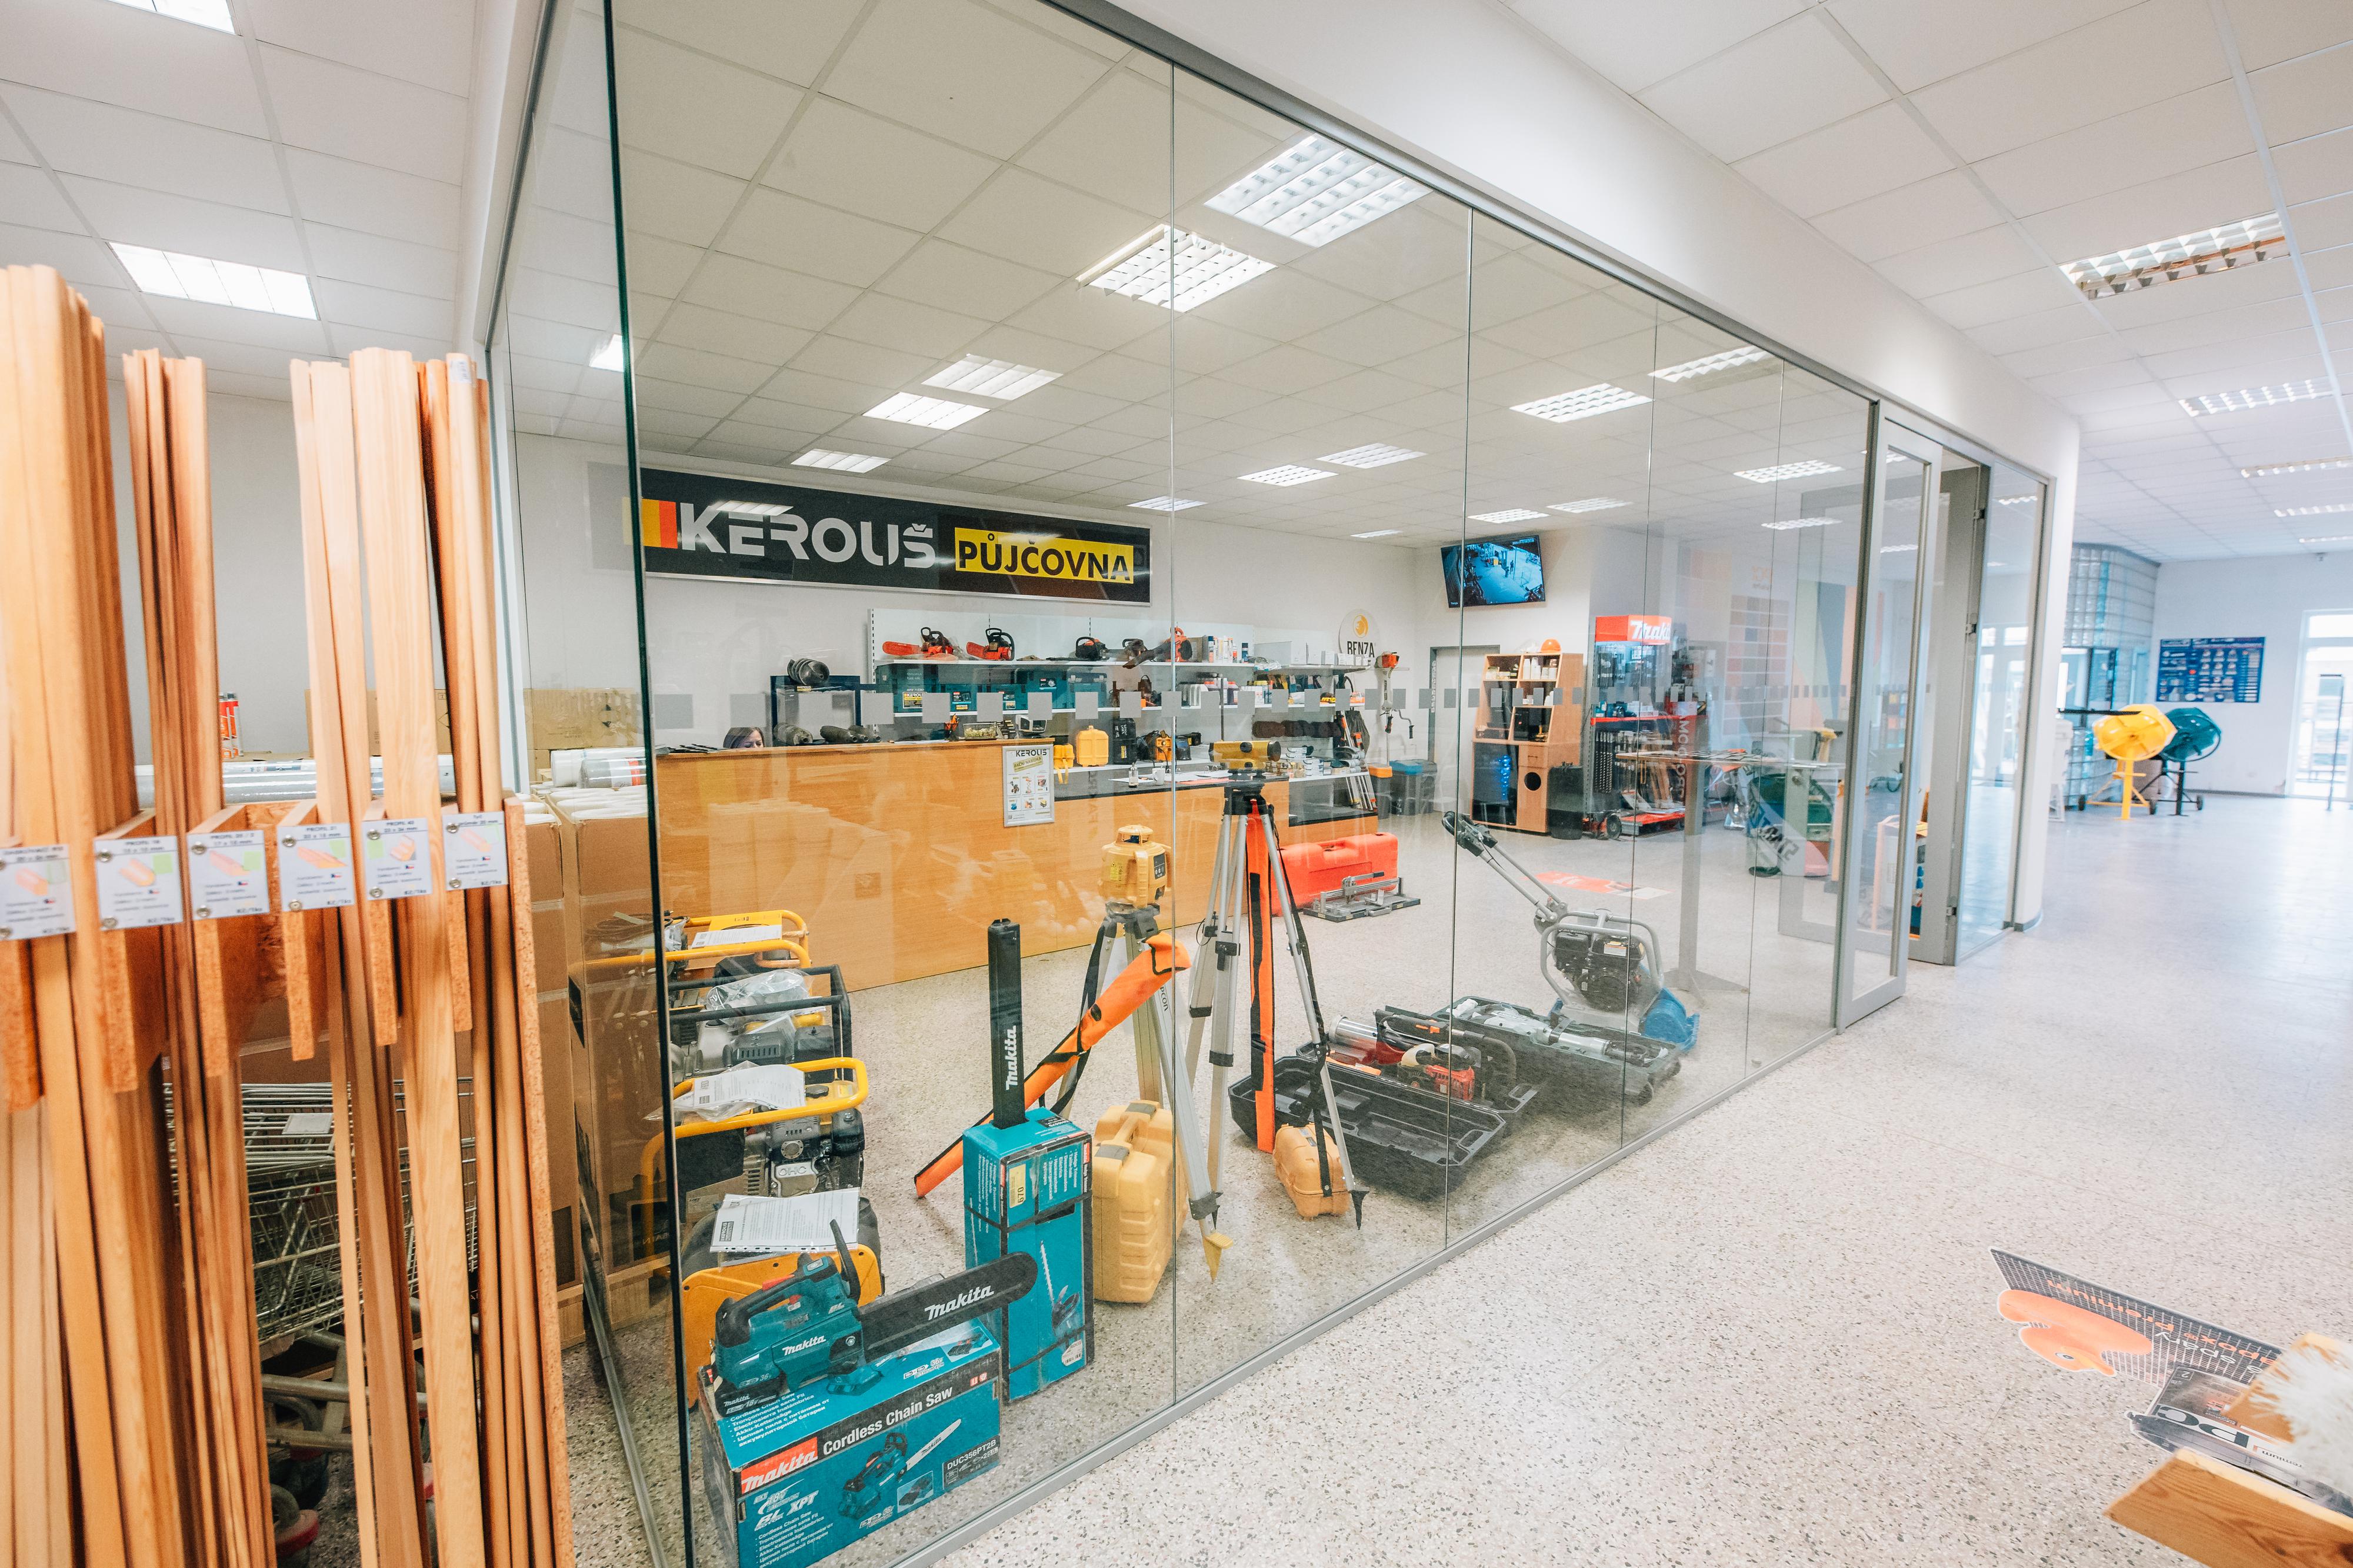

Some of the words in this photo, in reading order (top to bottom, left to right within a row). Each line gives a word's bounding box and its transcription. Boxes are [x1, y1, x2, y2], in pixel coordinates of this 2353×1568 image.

[679, 503, 936, 568] KEROUŠ
[958, 533, 1130, 582] PŮJČOVNA
[1347, 641, 1375, 658] BENZA
[1025, 756, 1042, 765] NABÍDKA
[2047, 1279, 2175, 1331] Premium
[2155, 1330, 2237, 1365] spáry
[730, 1408, 760, 1422] Cordless
[781, 1392, 795, 1400] Saw
[732, 1406, 779, 1426] Tronçonneuse
[780, 1397, 795, 1406] sans
[734, 1412, 776, 1431] Electrosierra
[777, 1394, 815, 1413] Inalámbrica
[823, 1420, 883, 1456] Cordless
[885, 1400, 922, 1426] Chain
[926, 1387, 953, 1407] Saw
[736, 1410, 792, 1437] Akku-Kettensäge
[737, 1428, 764, 1442] Цепная
[765, 1420, 782, 1429] пила
[789, 1403, 821, 1419] питанием
[739, 1417, 798, 1447] аккумуляторной
[947, 1439, 996, 1470] DUC356PT2B
[2261, 1449, 2307, 1469] remium
[786, 1490, 819, 1516] XPT
[758, 1525, 783, 1540] Cordless
[784, 1517, 799, 1527] Chain
[800, 1510, 812, 1519] Saw
[759, 1524, 797, 1545] Tronçonneuse
[798, 1517, 811, 1526] sans
[759, 1532, 794, 1552] Electrosierra
[794, 1516, 824, 1533] Inalámbrica
[759, 1532, 805, 1557] Akku-Kettensäge
[759, 1549, 781, 1563] Цепная
[781, 1543, 795, 1552] пила
[801, 1527, 826, 1542] питанием
